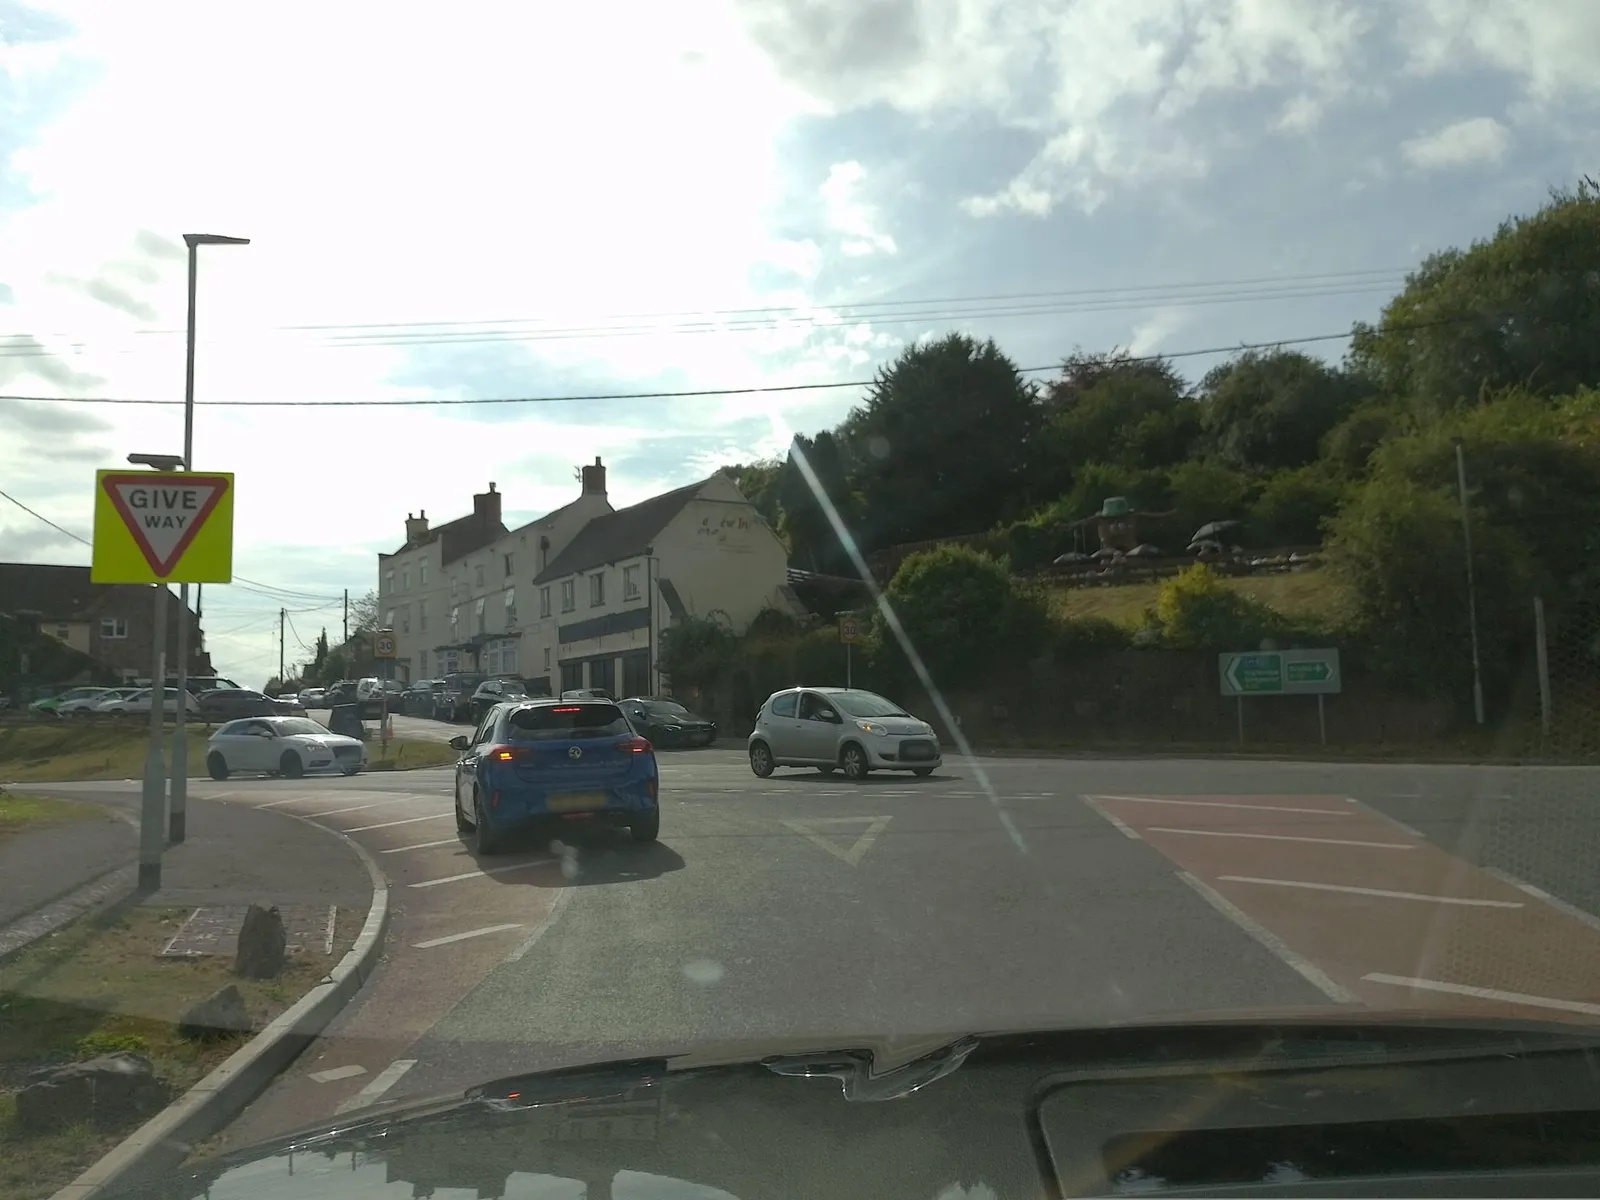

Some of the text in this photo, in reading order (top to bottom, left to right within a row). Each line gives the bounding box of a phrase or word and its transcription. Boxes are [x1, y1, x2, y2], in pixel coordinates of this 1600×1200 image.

[129, 489, 197, 509] GIVE
[144, 515, 187, 529] WAY
[844, 626, 856, 635] 30
[379, 641, 393, 650] 30
